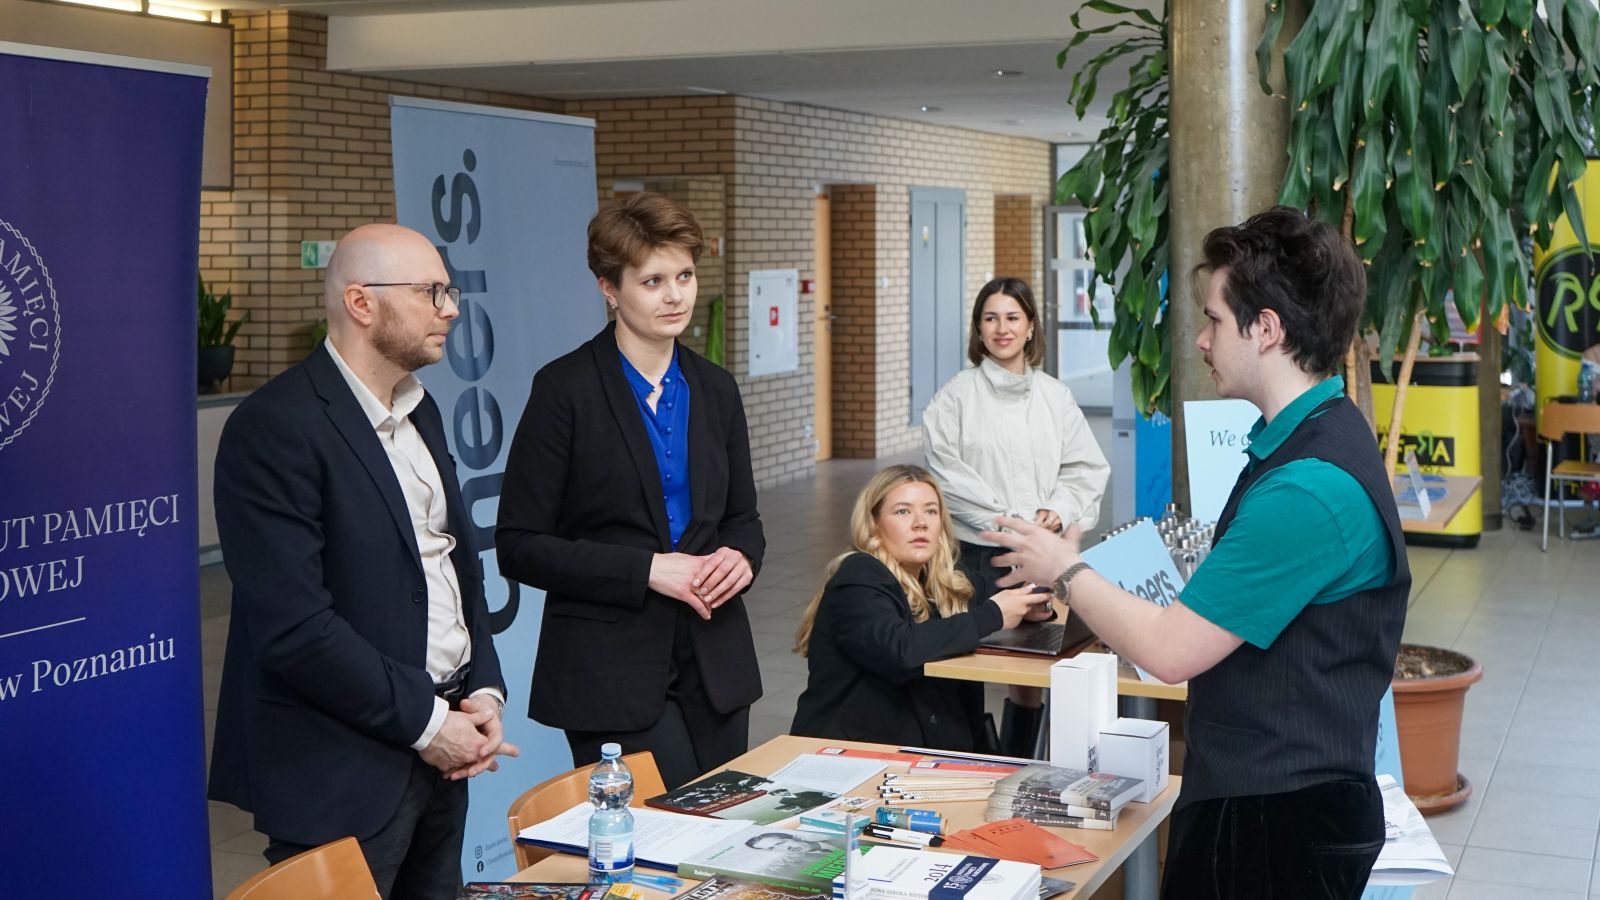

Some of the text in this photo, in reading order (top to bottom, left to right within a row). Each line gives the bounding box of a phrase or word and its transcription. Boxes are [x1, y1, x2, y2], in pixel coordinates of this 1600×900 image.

[1209, 430, 1236, 447] We
[42, 494, 180, 545] PAMIĘCI
[0, 633, 176, 700] w Poznaniu
[924, 863, 953, 883] 2014
